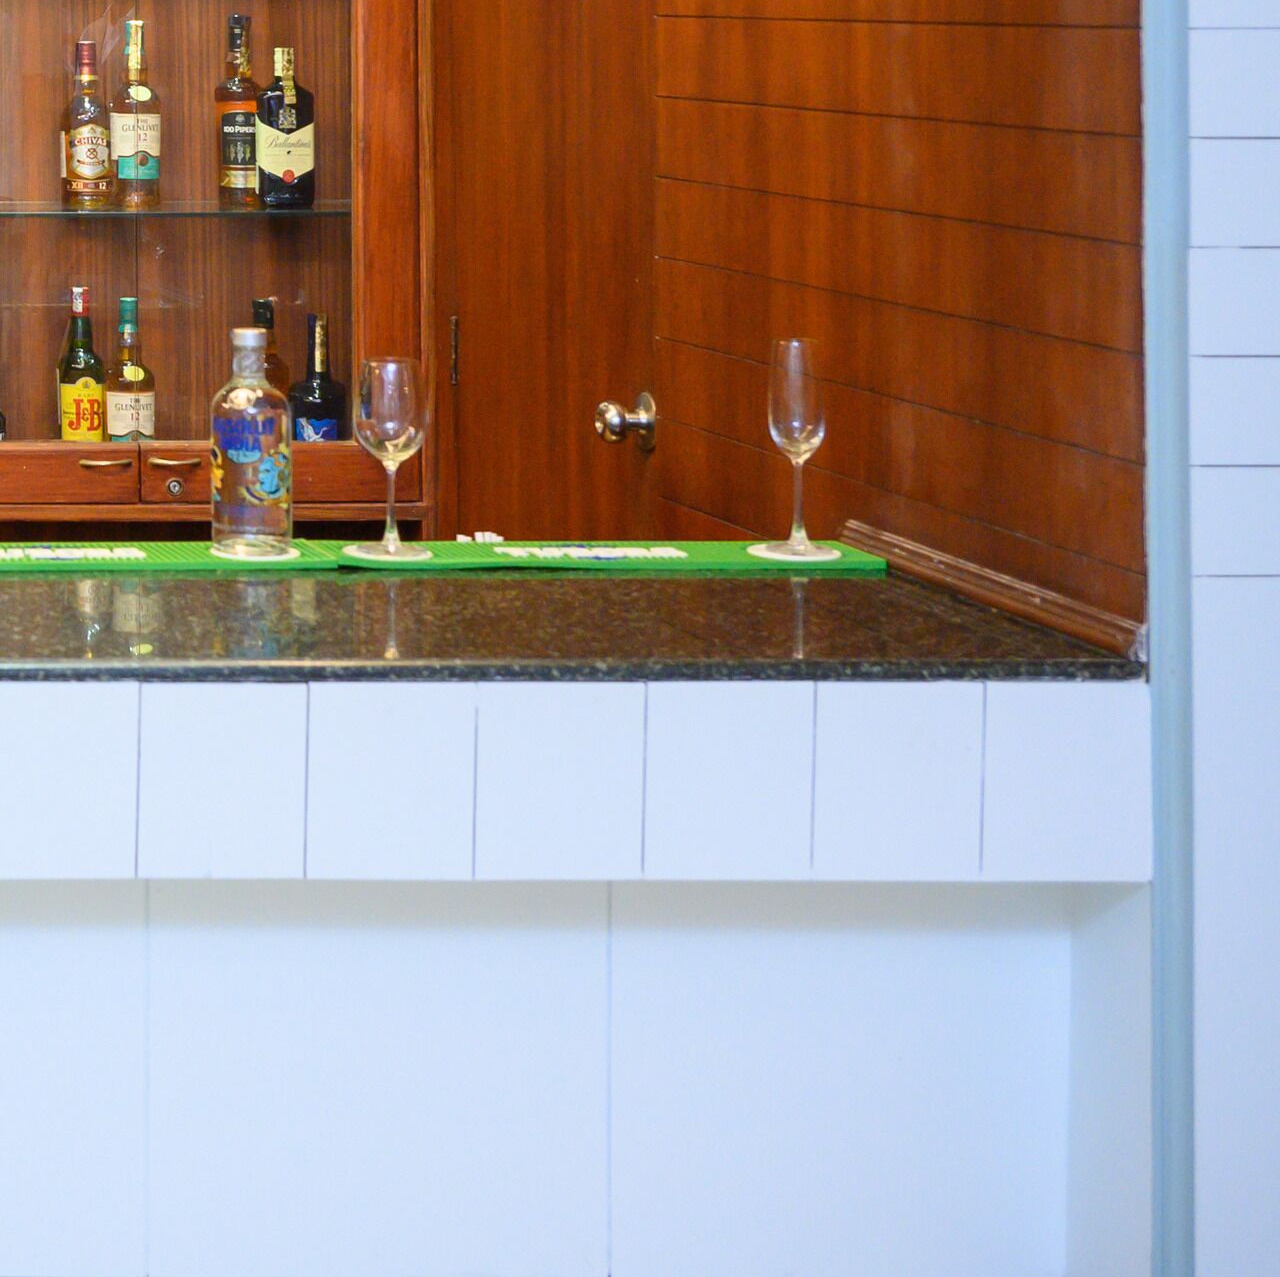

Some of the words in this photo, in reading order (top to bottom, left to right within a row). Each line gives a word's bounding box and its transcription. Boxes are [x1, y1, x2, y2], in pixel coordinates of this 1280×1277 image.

[121, 124, 160, 133] GLENLIVET
[223, 125, 235, 133] 100
[74, 136, 108, 147] CHIVAS
[138, 132, 148, 142] 12
[71, 181, 84, 190] XII
[98, 181, 107, 190] 12
[114, 403, 153, 412] GLENLIVET
[67, 398, 102, 432] J&B
[130, 412, 140, 421] 12
